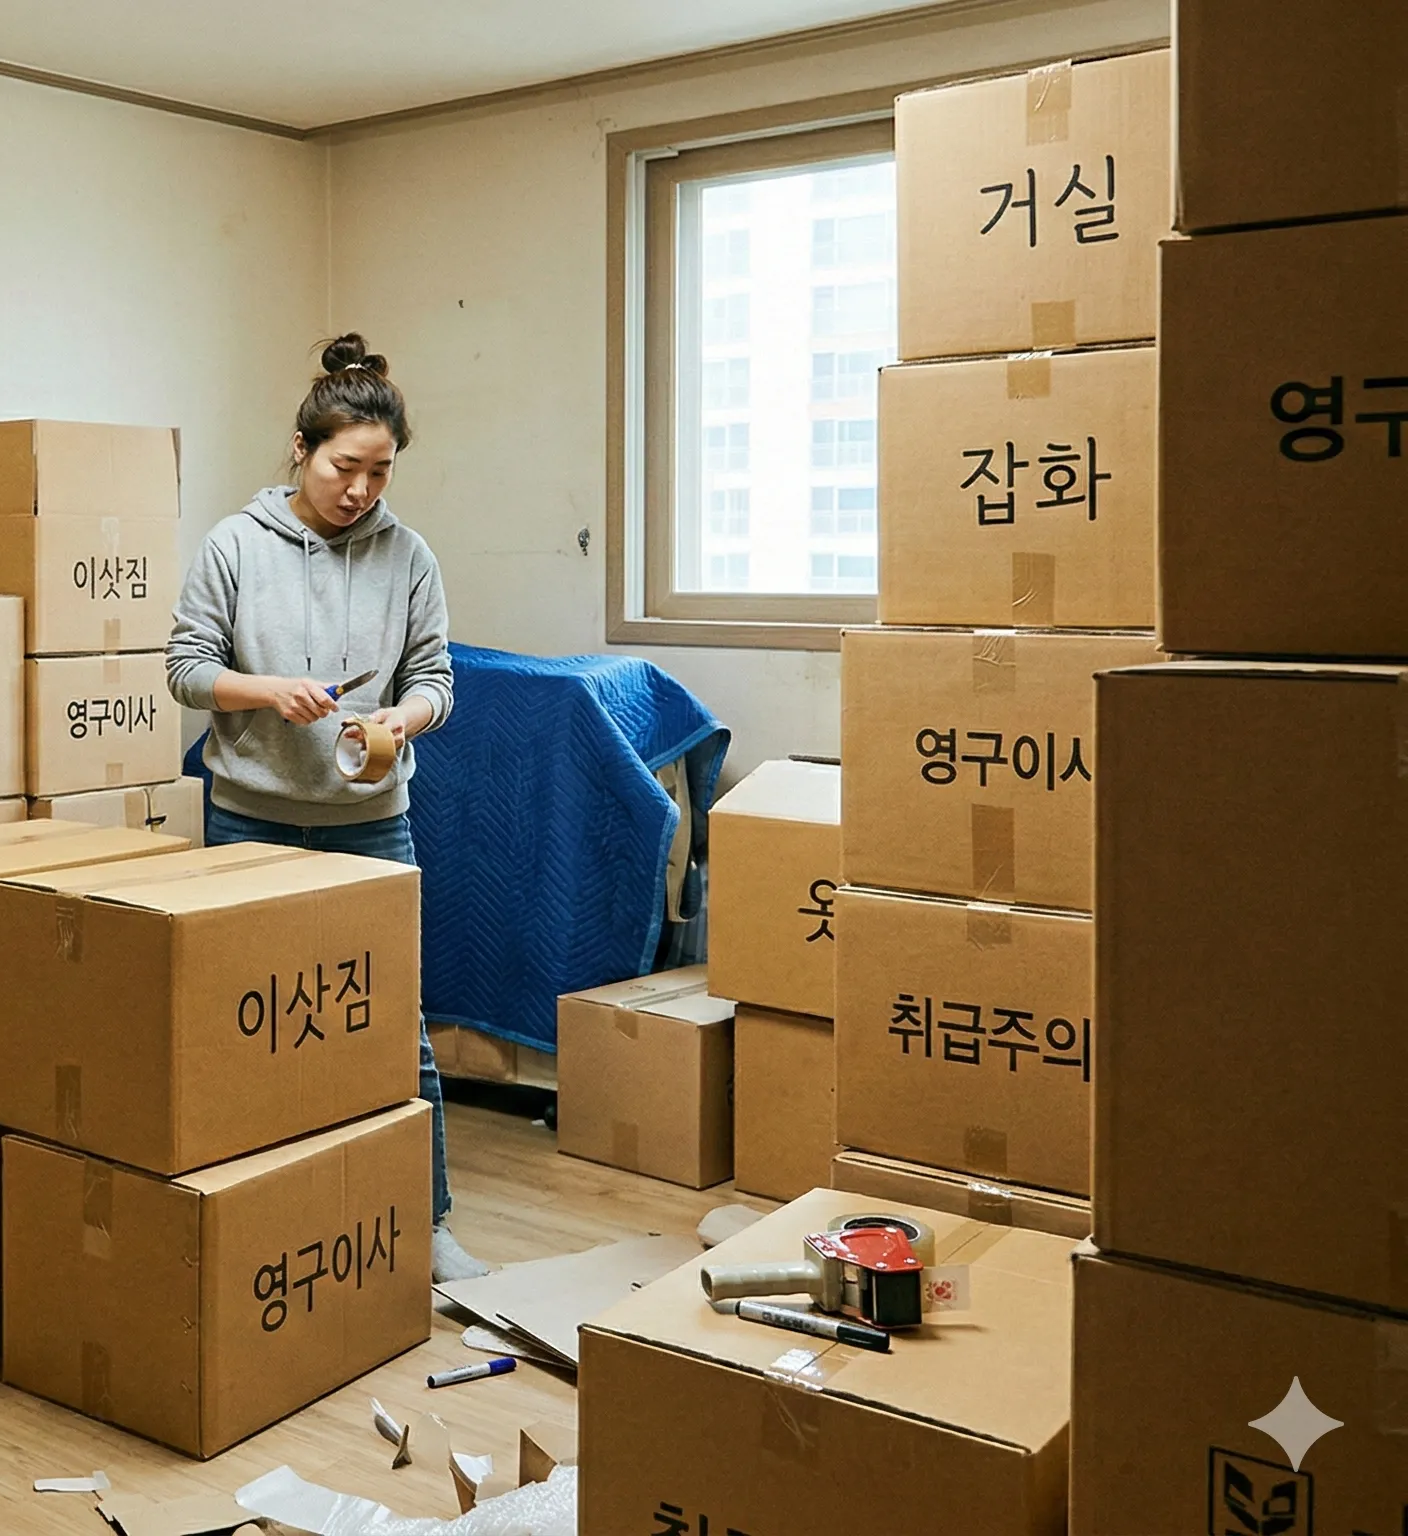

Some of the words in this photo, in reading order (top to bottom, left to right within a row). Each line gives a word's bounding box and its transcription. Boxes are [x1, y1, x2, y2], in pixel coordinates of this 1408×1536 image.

[980, 154, 1120, 248] 거실
[960, 436, 1112, 526] 잡화
[73, 556, 147, 600] 이삿짐
[67, 694, 157, 739] 영구이사
[237, 950, 371, 1055] 이삿짐
[888, 993, 1091, 1083] 취급주의
[253, 1205, 401, 1333] 영구이사
